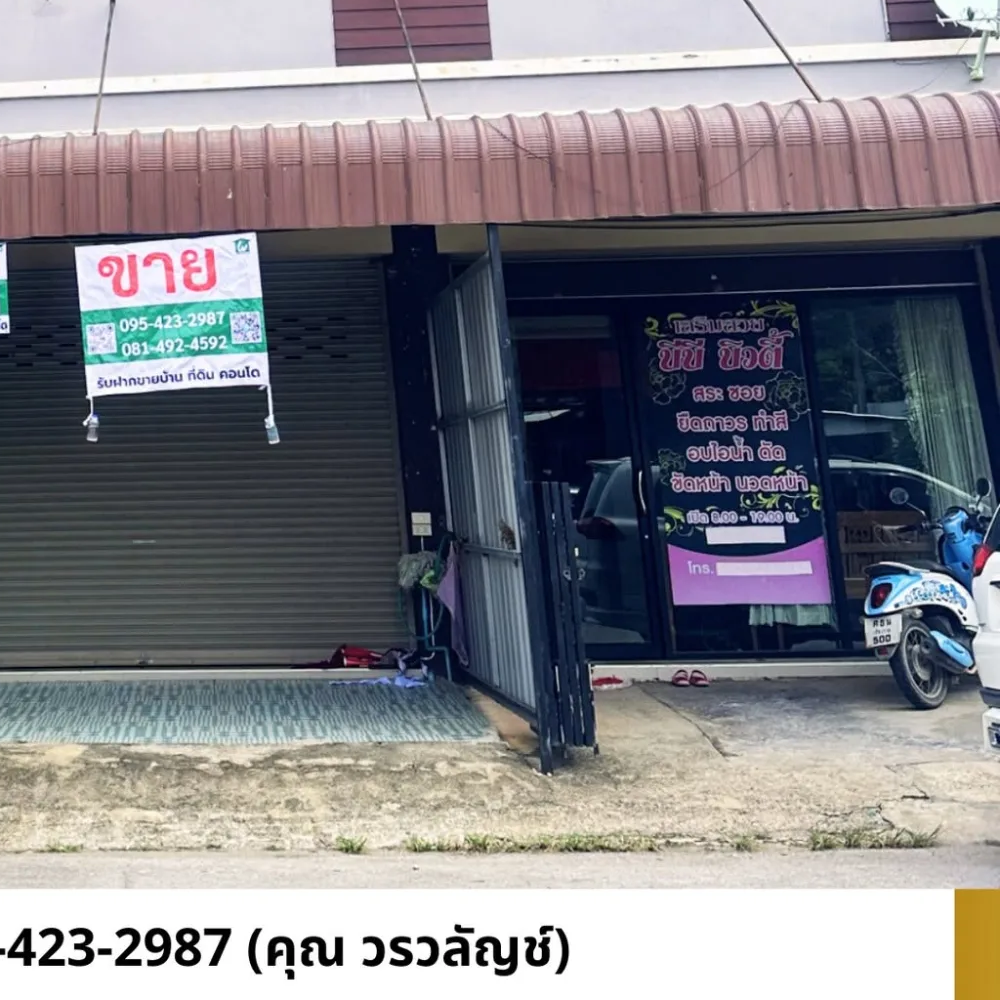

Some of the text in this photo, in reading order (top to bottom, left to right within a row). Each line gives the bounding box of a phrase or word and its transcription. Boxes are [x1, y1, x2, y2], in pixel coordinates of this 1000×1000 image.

[98, 248, 217, 297] ขาย
[119, 311, 225, 332] 095-423-2987
[121, 335, 227, 356] 081-492-4592
[96, 366, 260, 389] รับฝากขายบ้าน ที่ดิน คอนโด
[692, 385, 766, 402] สระ ซอย
[676, 409, 789, 432] ยืดถาวร ทำสี
[686, 435, 786, 462] อบไอน้ำ ดัด
[670, 469, 809, 492] ขัดหน้า นวดหน้า
[686, 509, 709, 524] เปิด
[711, 510, 738, 524] 8.00
[750, 510, 784, 524] 19.00
[687, 560, 714, 574] โทร.
